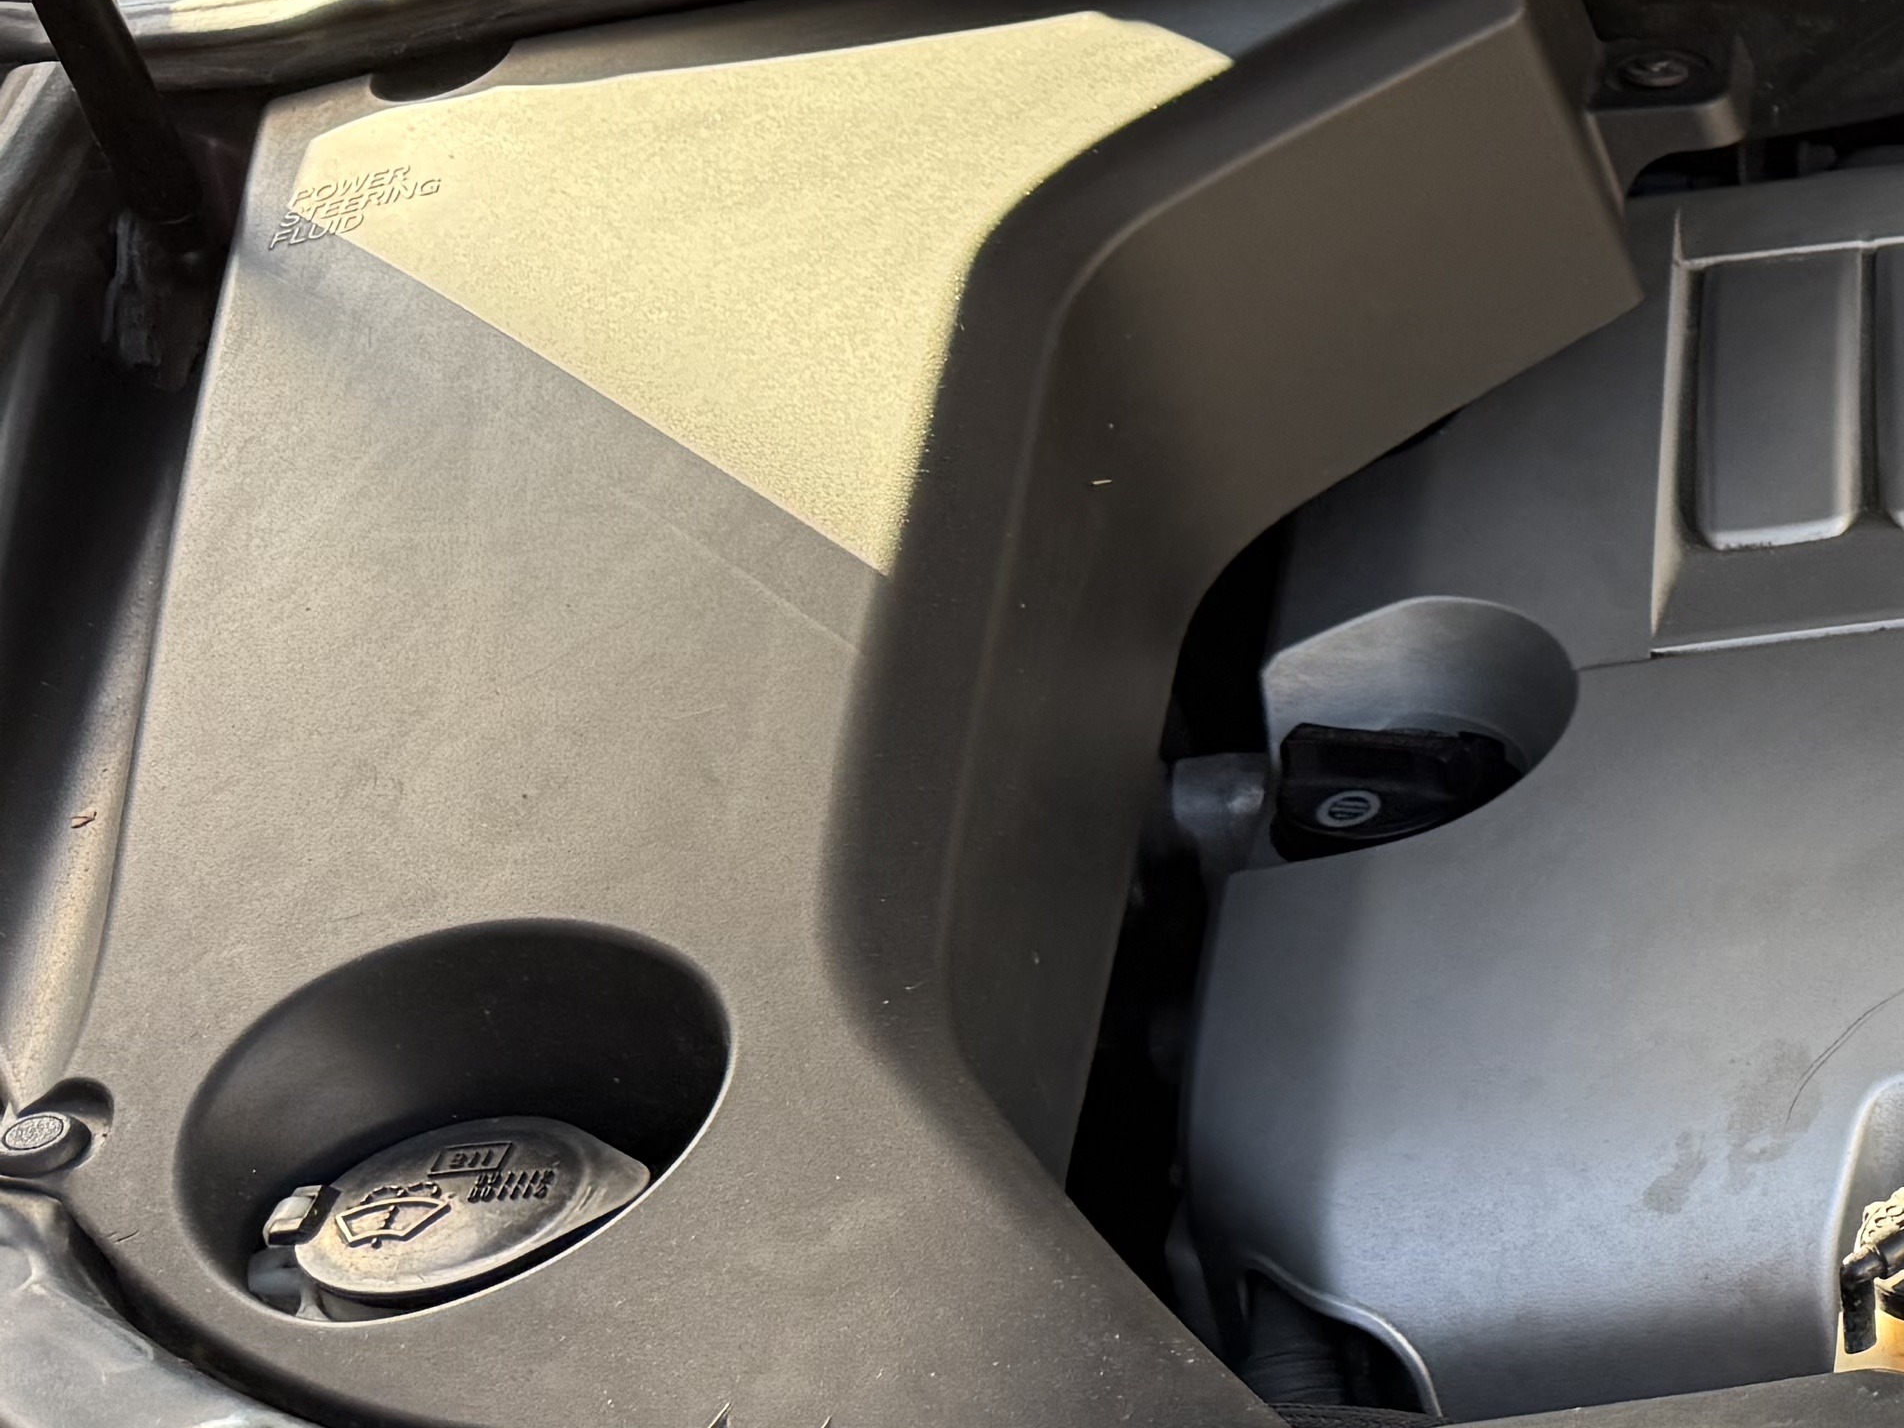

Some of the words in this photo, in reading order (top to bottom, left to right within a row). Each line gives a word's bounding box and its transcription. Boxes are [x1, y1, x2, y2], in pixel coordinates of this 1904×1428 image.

[280, 178, 442, 228] STEERING
[287, 165, 411, 209] POWER
[269, 213, 365, 252] FLUID
